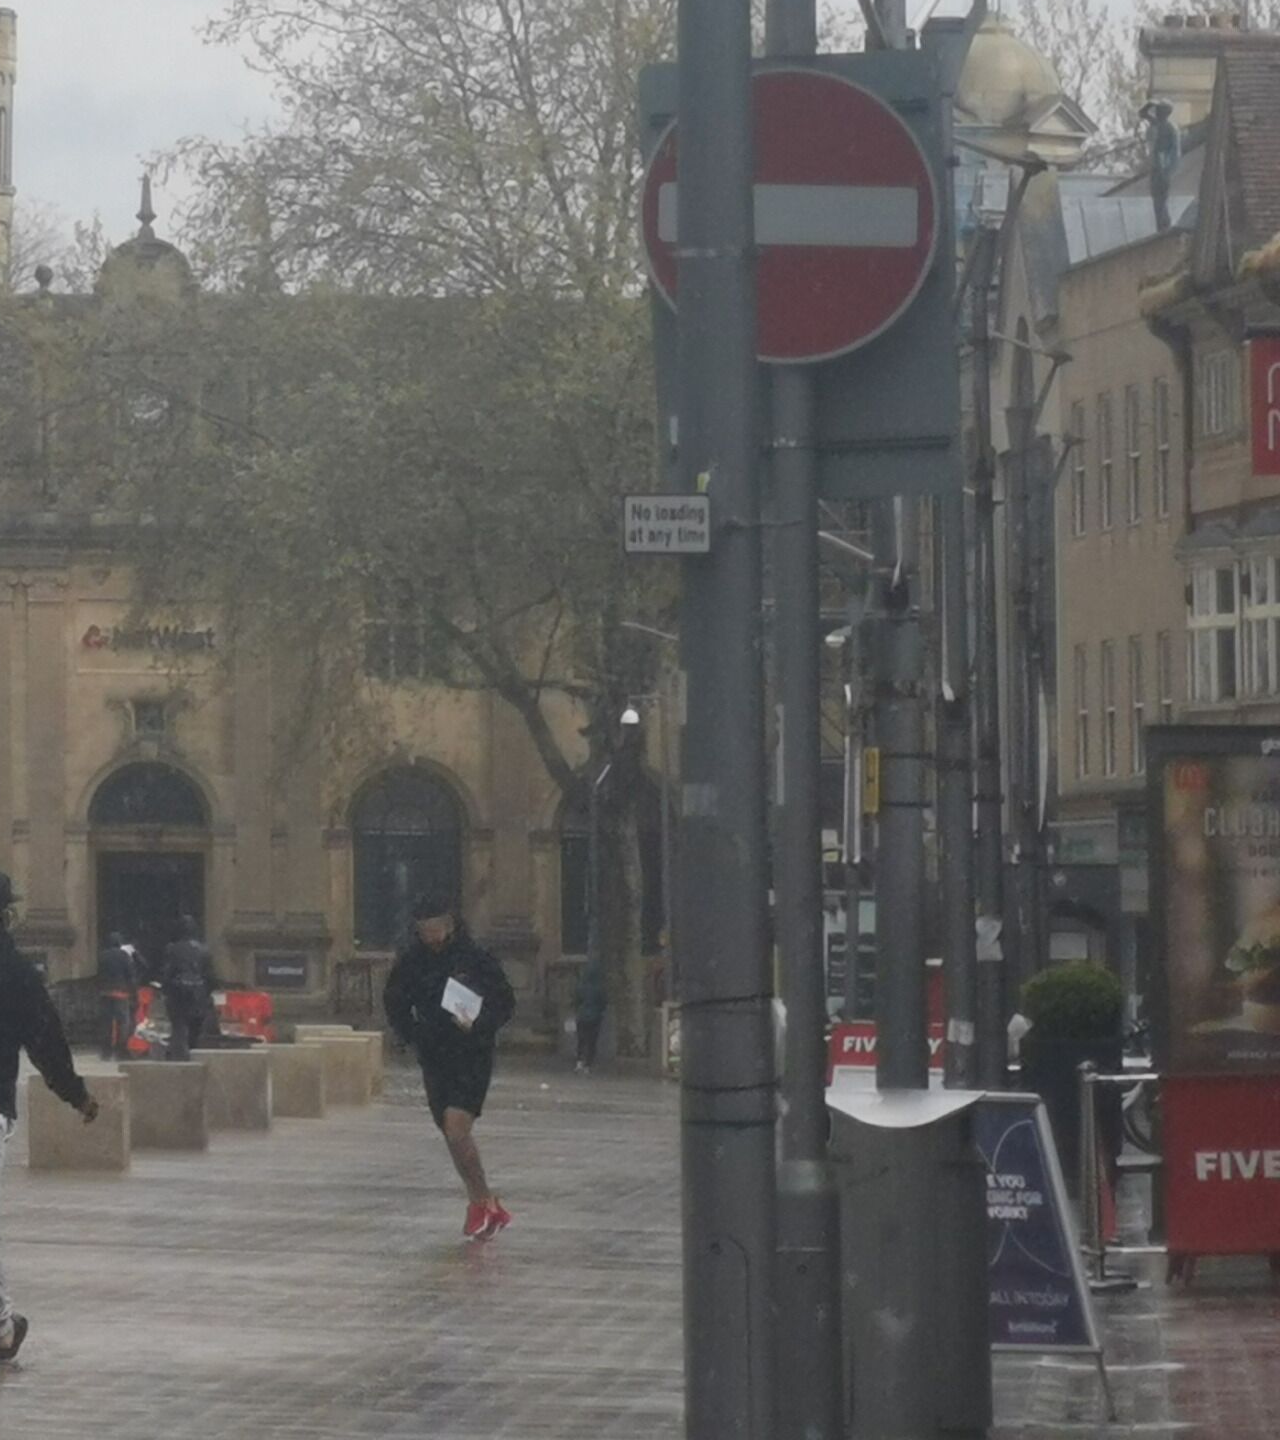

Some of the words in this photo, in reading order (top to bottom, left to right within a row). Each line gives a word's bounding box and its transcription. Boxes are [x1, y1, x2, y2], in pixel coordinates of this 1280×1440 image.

[631, 504, 651, 520] No
[654, 504, 705, 525] loading
[648, 528, 673, 547] any
[842, 1036, 877, 1053] FIV
